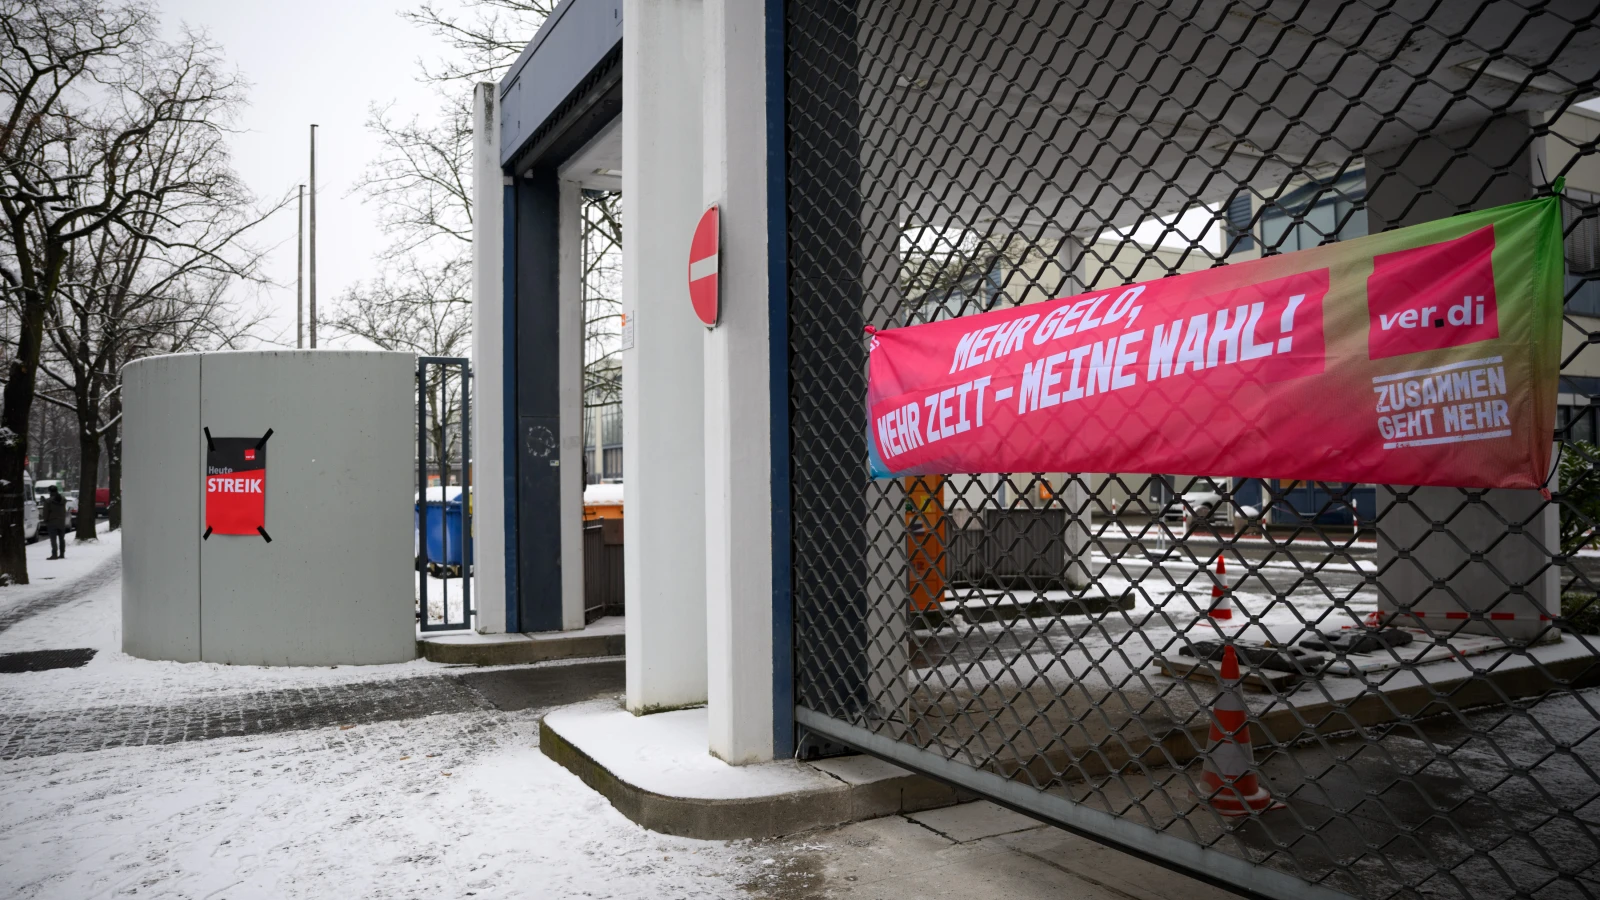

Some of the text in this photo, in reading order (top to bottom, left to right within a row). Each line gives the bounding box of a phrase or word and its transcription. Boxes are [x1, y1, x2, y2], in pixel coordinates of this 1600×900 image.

[949, 286, 1146, 374] MEHR GELD,
[1379, 295, 1484, 331] ver.di
[877, 401, 924, 460] MEHR
[924, 375, 992, 443] ZEIT
[1019, 329, 1145, 415] MEINE
[1147, 294, 1306, 382] WAHL!
[1373, 366, 1507, 413] ZUSAMMEN
[1377, 399, 1510, 440] GEHT MEHR
[208, 466, 233, 474] Heute
[208, 478, 262, 493] STREIK
